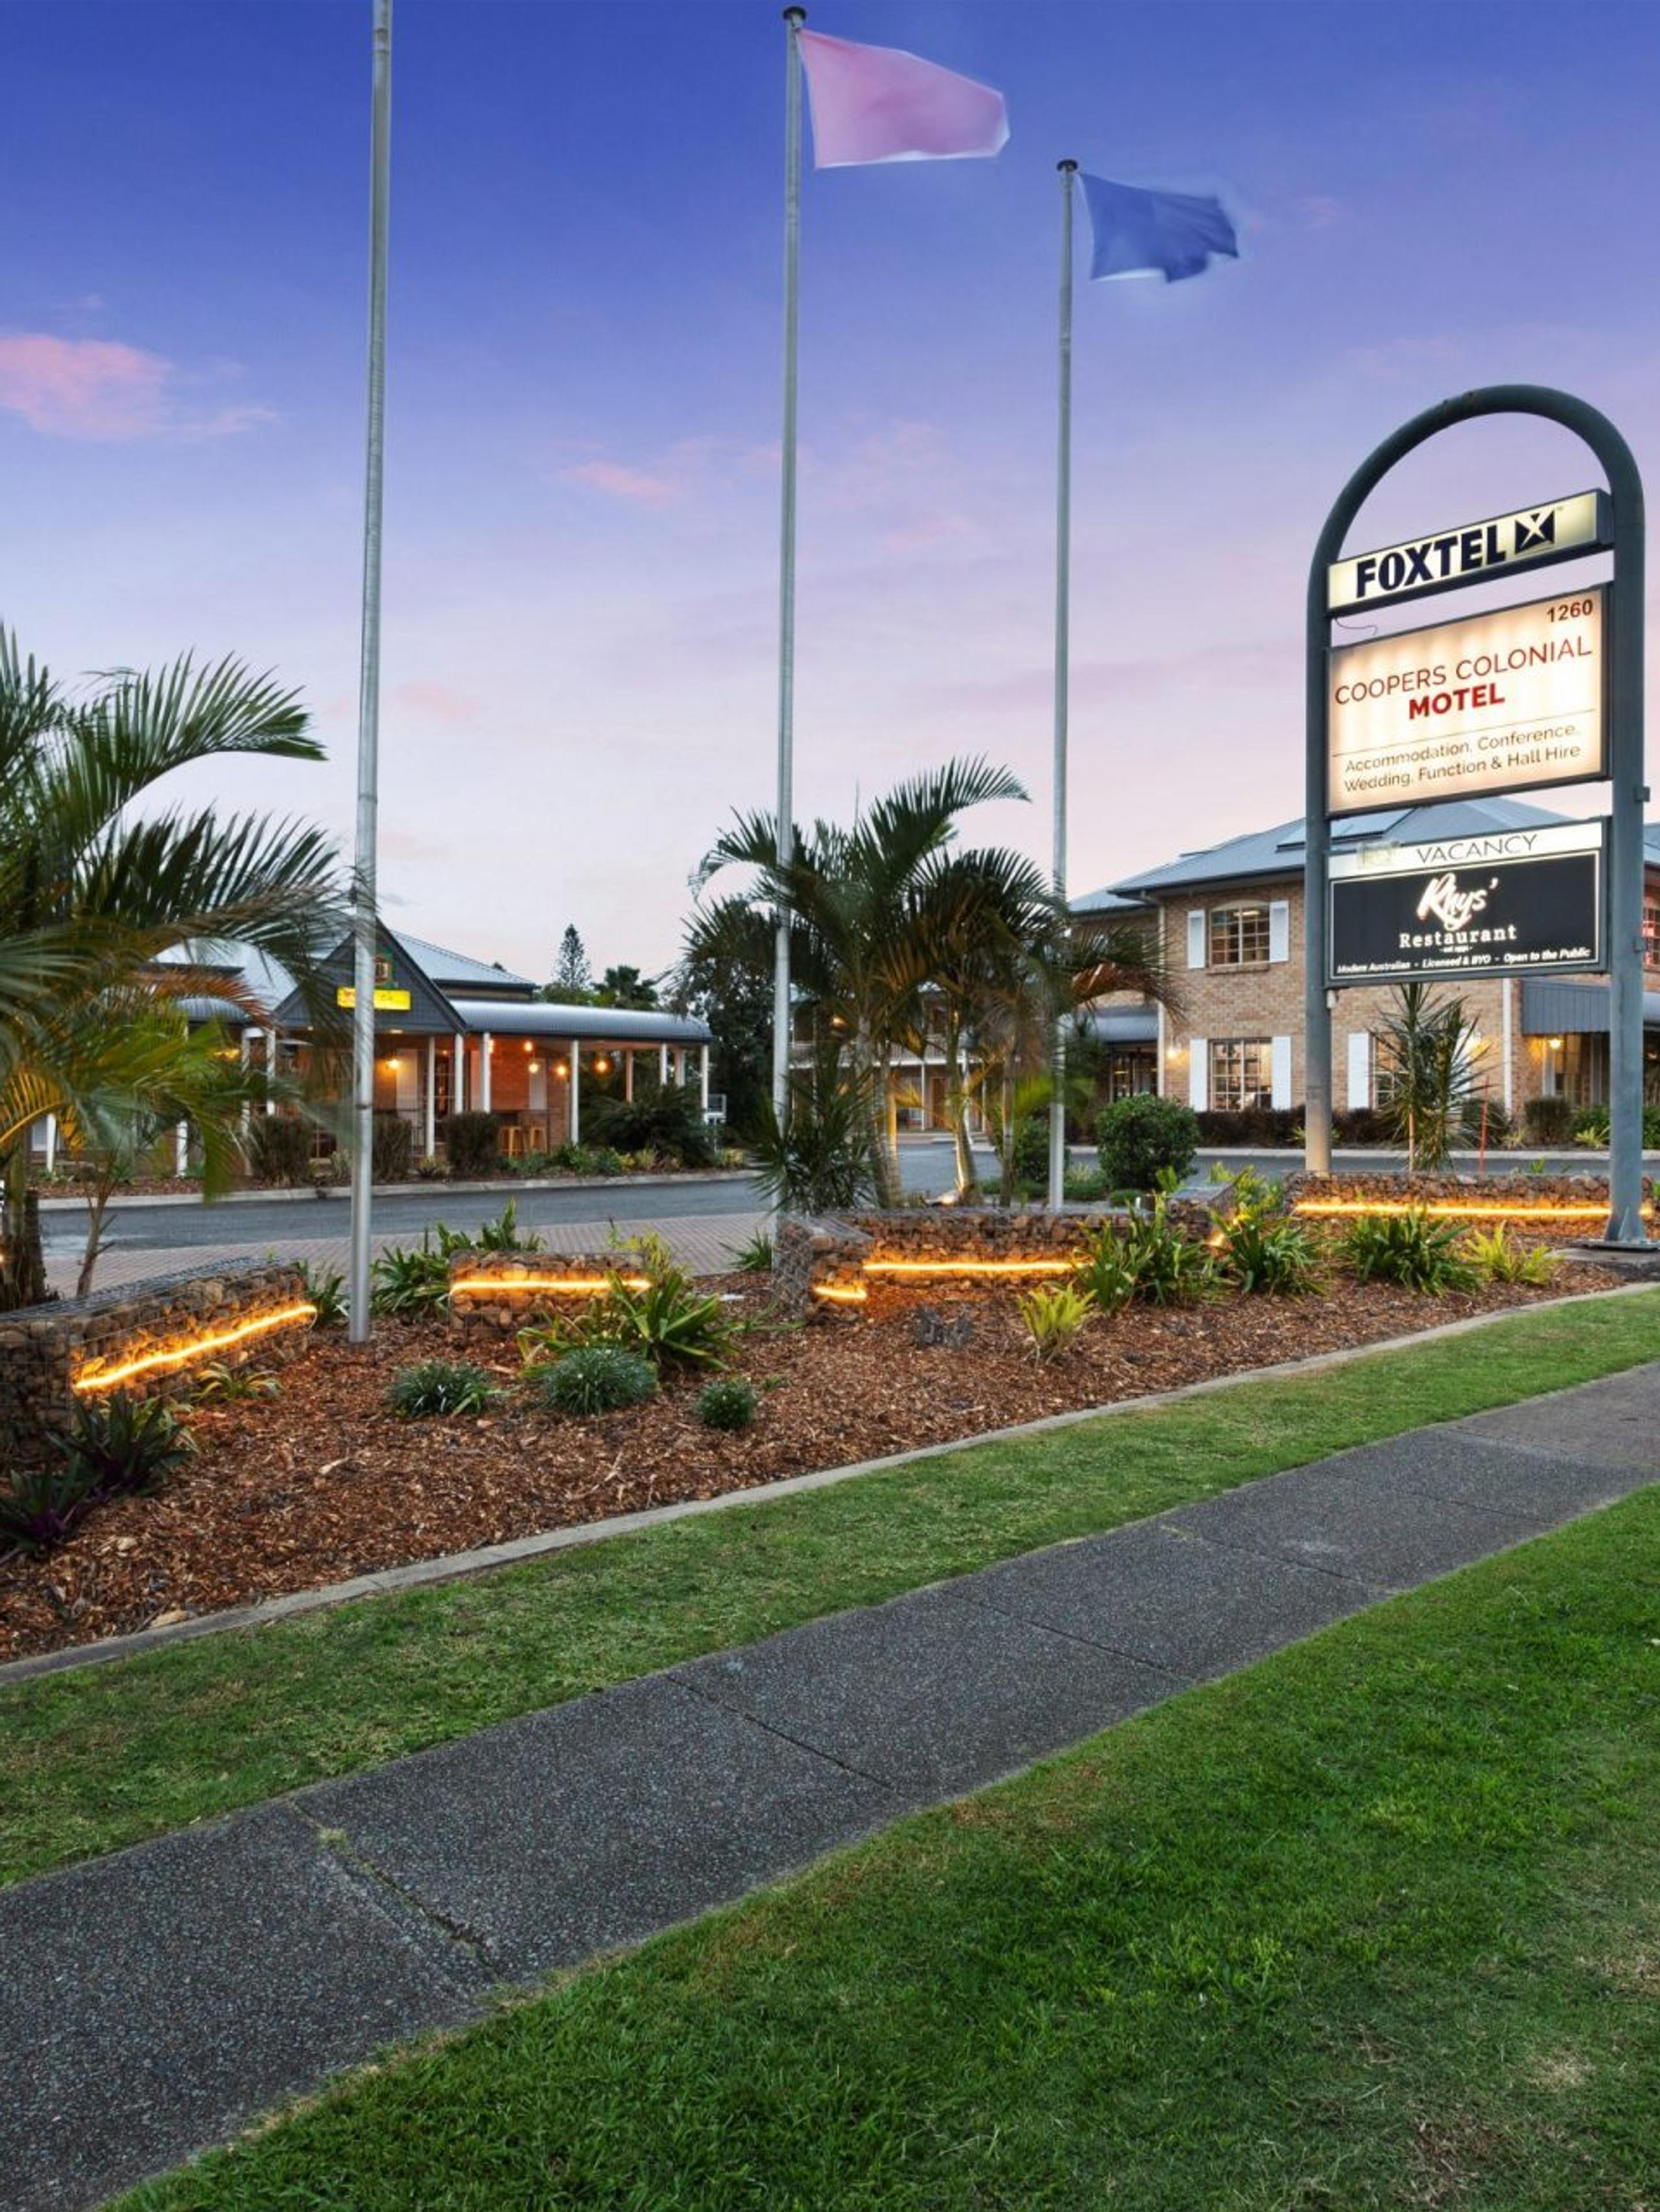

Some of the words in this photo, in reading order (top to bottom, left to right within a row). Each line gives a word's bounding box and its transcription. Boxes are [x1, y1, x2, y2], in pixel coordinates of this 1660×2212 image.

[1357, 525, 1506, 598] FOXTEL
[1547, 599, 1593, 622] 1260
[1335, 665, 1447, 705] COOPERS
[1456, 635, 1593, 680] COLONIAL
[1409, 683, 1505, 720] MOTEL
[1419, 760, 1486, 781] Function
[1491, 756, 1502, 770] &
[1508, 748, 1541, 767] Hall
[1546, 746, 1581, 761] Hire
[1417, 834, 1537, 864] VACANCY
[1399, 924, 1517, 948] Restaurant
[1422, 956, 1462, 969] Licensed
[1472, 954, 1491, 965] BYO
[1504, 953, 1528, 965] Open
[1530, 952, 1540, 961] to
[1542, 950, 1558, 961] the
[1559, 947, 1591, 959] Public
